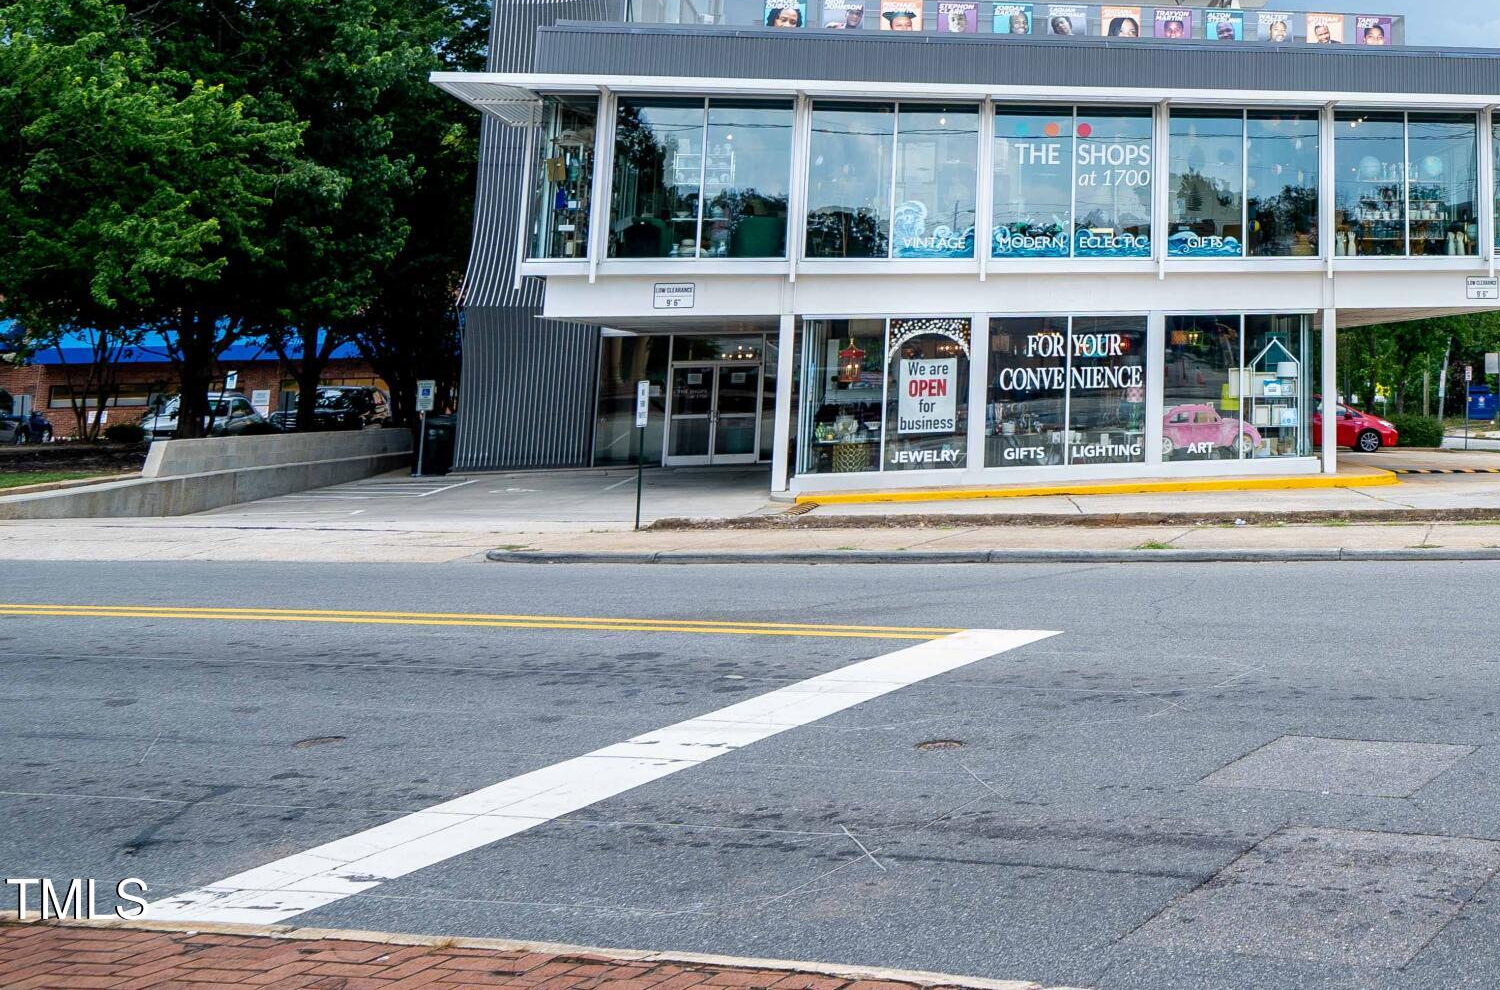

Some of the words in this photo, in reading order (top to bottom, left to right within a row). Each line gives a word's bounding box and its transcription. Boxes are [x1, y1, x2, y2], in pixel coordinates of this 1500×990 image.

[1014, 143, 1061, 165] THE
[1077, 144, 1150, 166] SHOPS
[1078, 171, 1097, 186] at
[1103, 169, 1150, 186] 1700
[903, 236, 966, 250] VINTAGE
[999, 236, 1064, 249] MODERN
[1079, 236, 1145, 249] ECLECTIC
[1188, 236, 1223, 248] GIFTS
[1027, 334, 1066, 357] FOR
[1072, 334, 1123, 357] YOUR
[908, 361, 927, 376] We
[929, 364, 949, 375] are
[1000, 365, 1143, 391] CONVENIENCE
[909, 378, 947, 397] OPEN
[918, 399, 936, 413] for
[900, 415, 954, 431] business
[1003, 446, 1045, 460] GIFTS
[1072, 443, 1141, 458] LIGHTING
[1187, 441, 1214, 454] ART
[891, 448, 960, 464] JEWELRY
